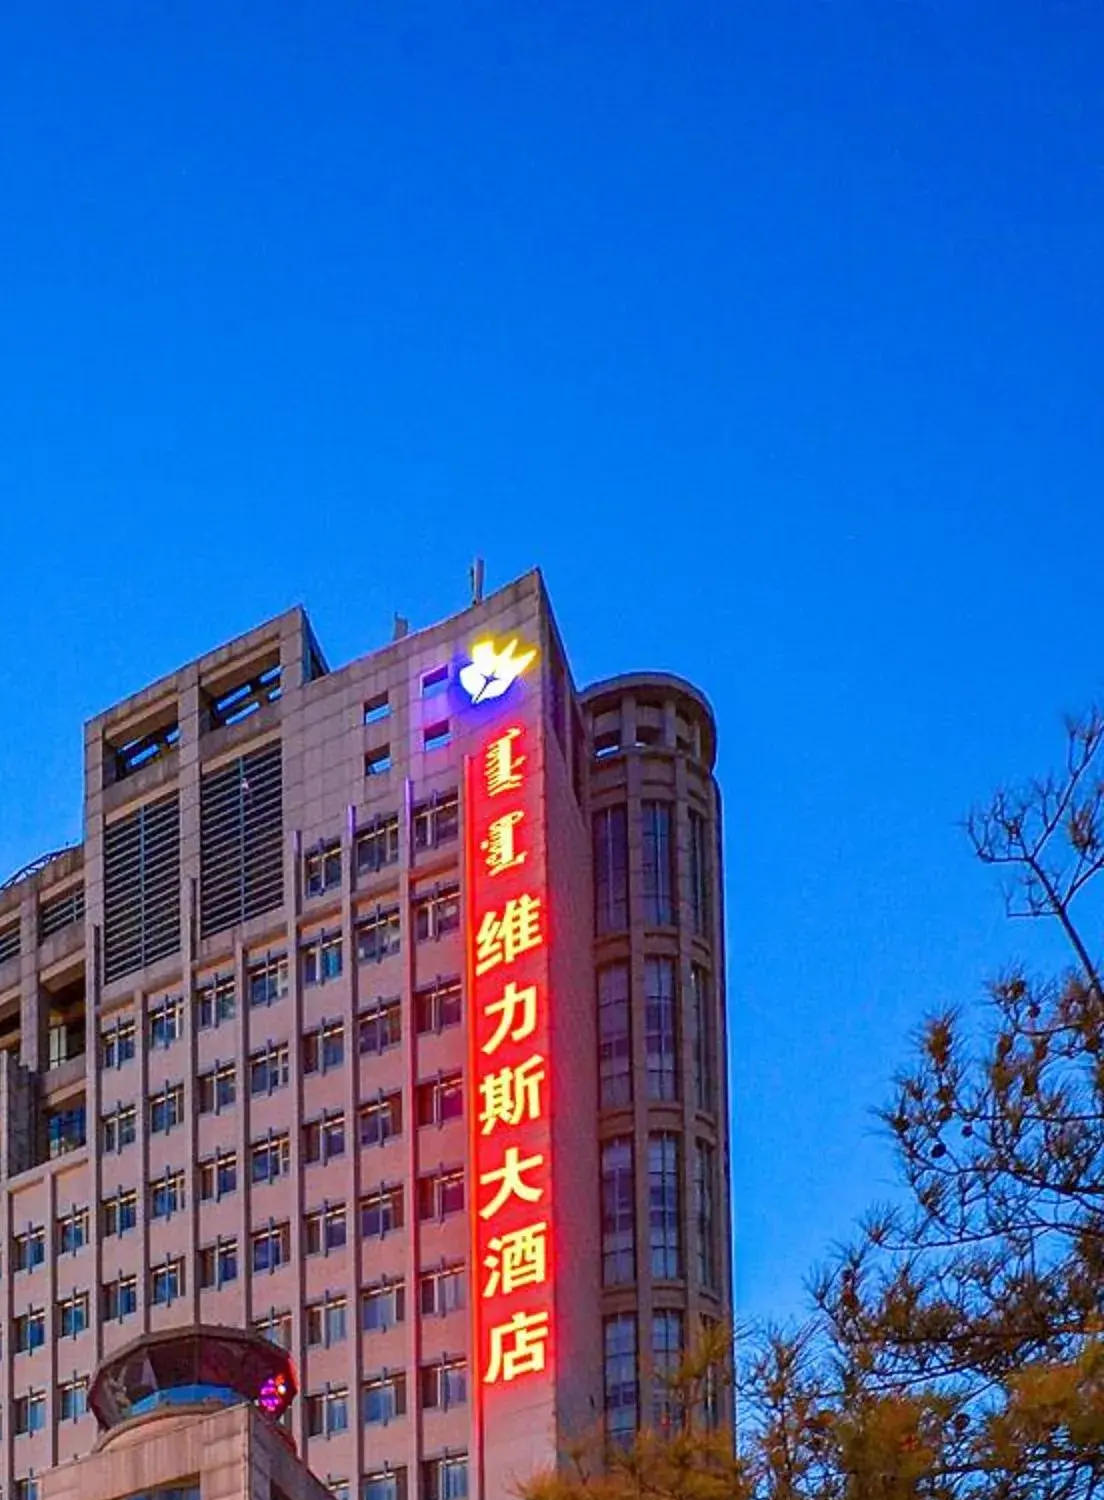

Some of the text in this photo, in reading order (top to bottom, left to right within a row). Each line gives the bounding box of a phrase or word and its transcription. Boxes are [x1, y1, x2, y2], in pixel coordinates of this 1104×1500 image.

[475, 893, 548, 1384] 维力斯大酒店
